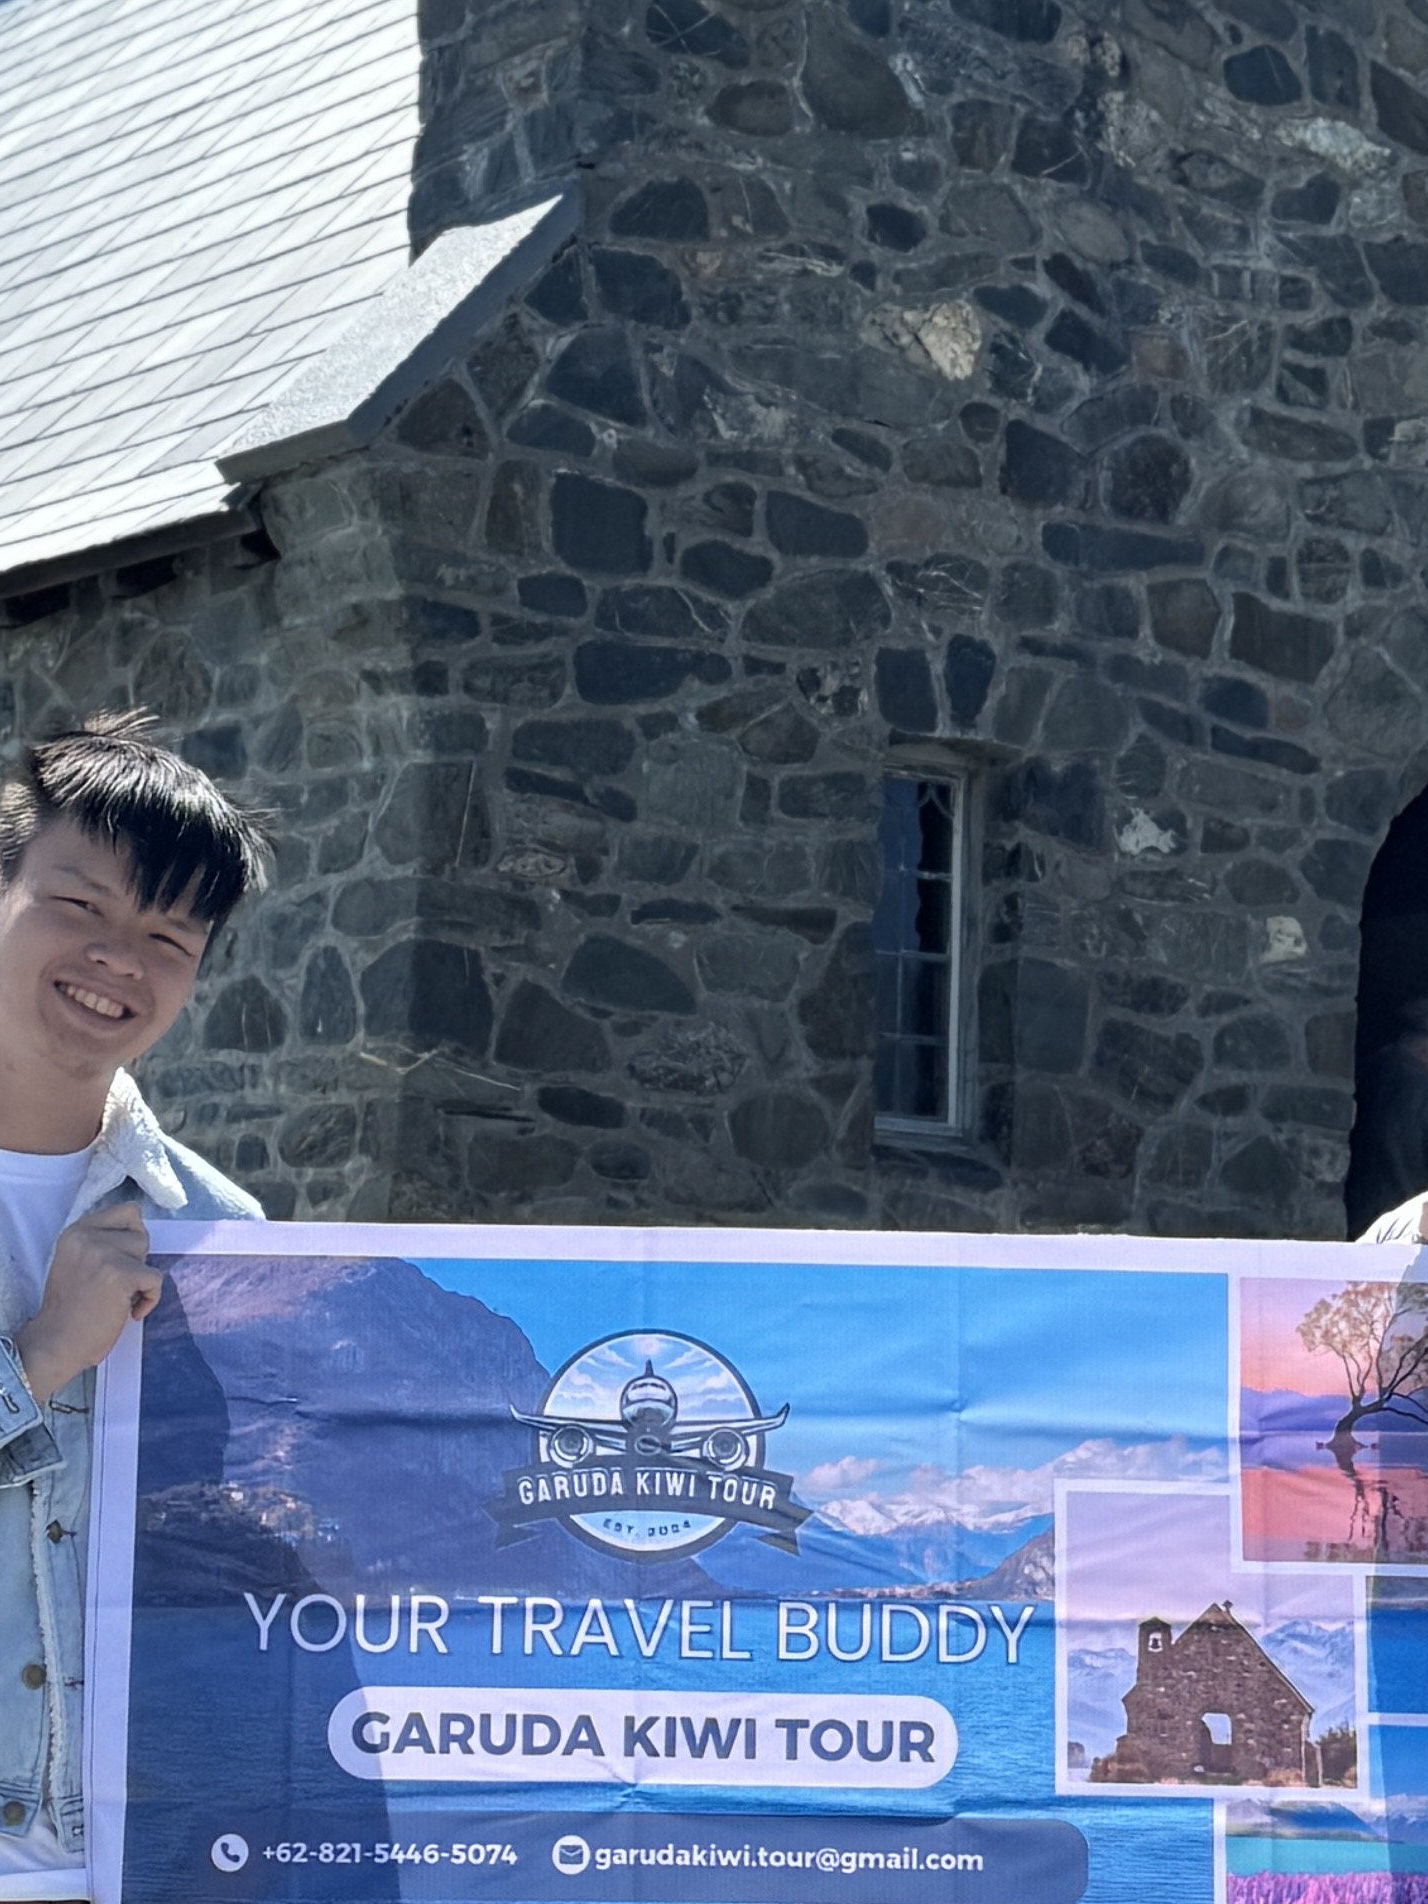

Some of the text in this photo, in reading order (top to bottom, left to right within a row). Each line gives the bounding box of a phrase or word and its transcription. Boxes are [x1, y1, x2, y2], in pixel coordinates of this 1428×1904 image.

[518, 1472, 777, 1510] GARUDA KIWI TOUR
[243, 1592, 1036, 1664] YOUR TRAVEL BUDDY
[351, 1710, 936, 1763] GARUDA KIWI TOUR
[262, 1841, 518, 1865] +62-821-5446-5074
[594, 1842, 984, 1874] garudakiwi.tour@gmail.com
